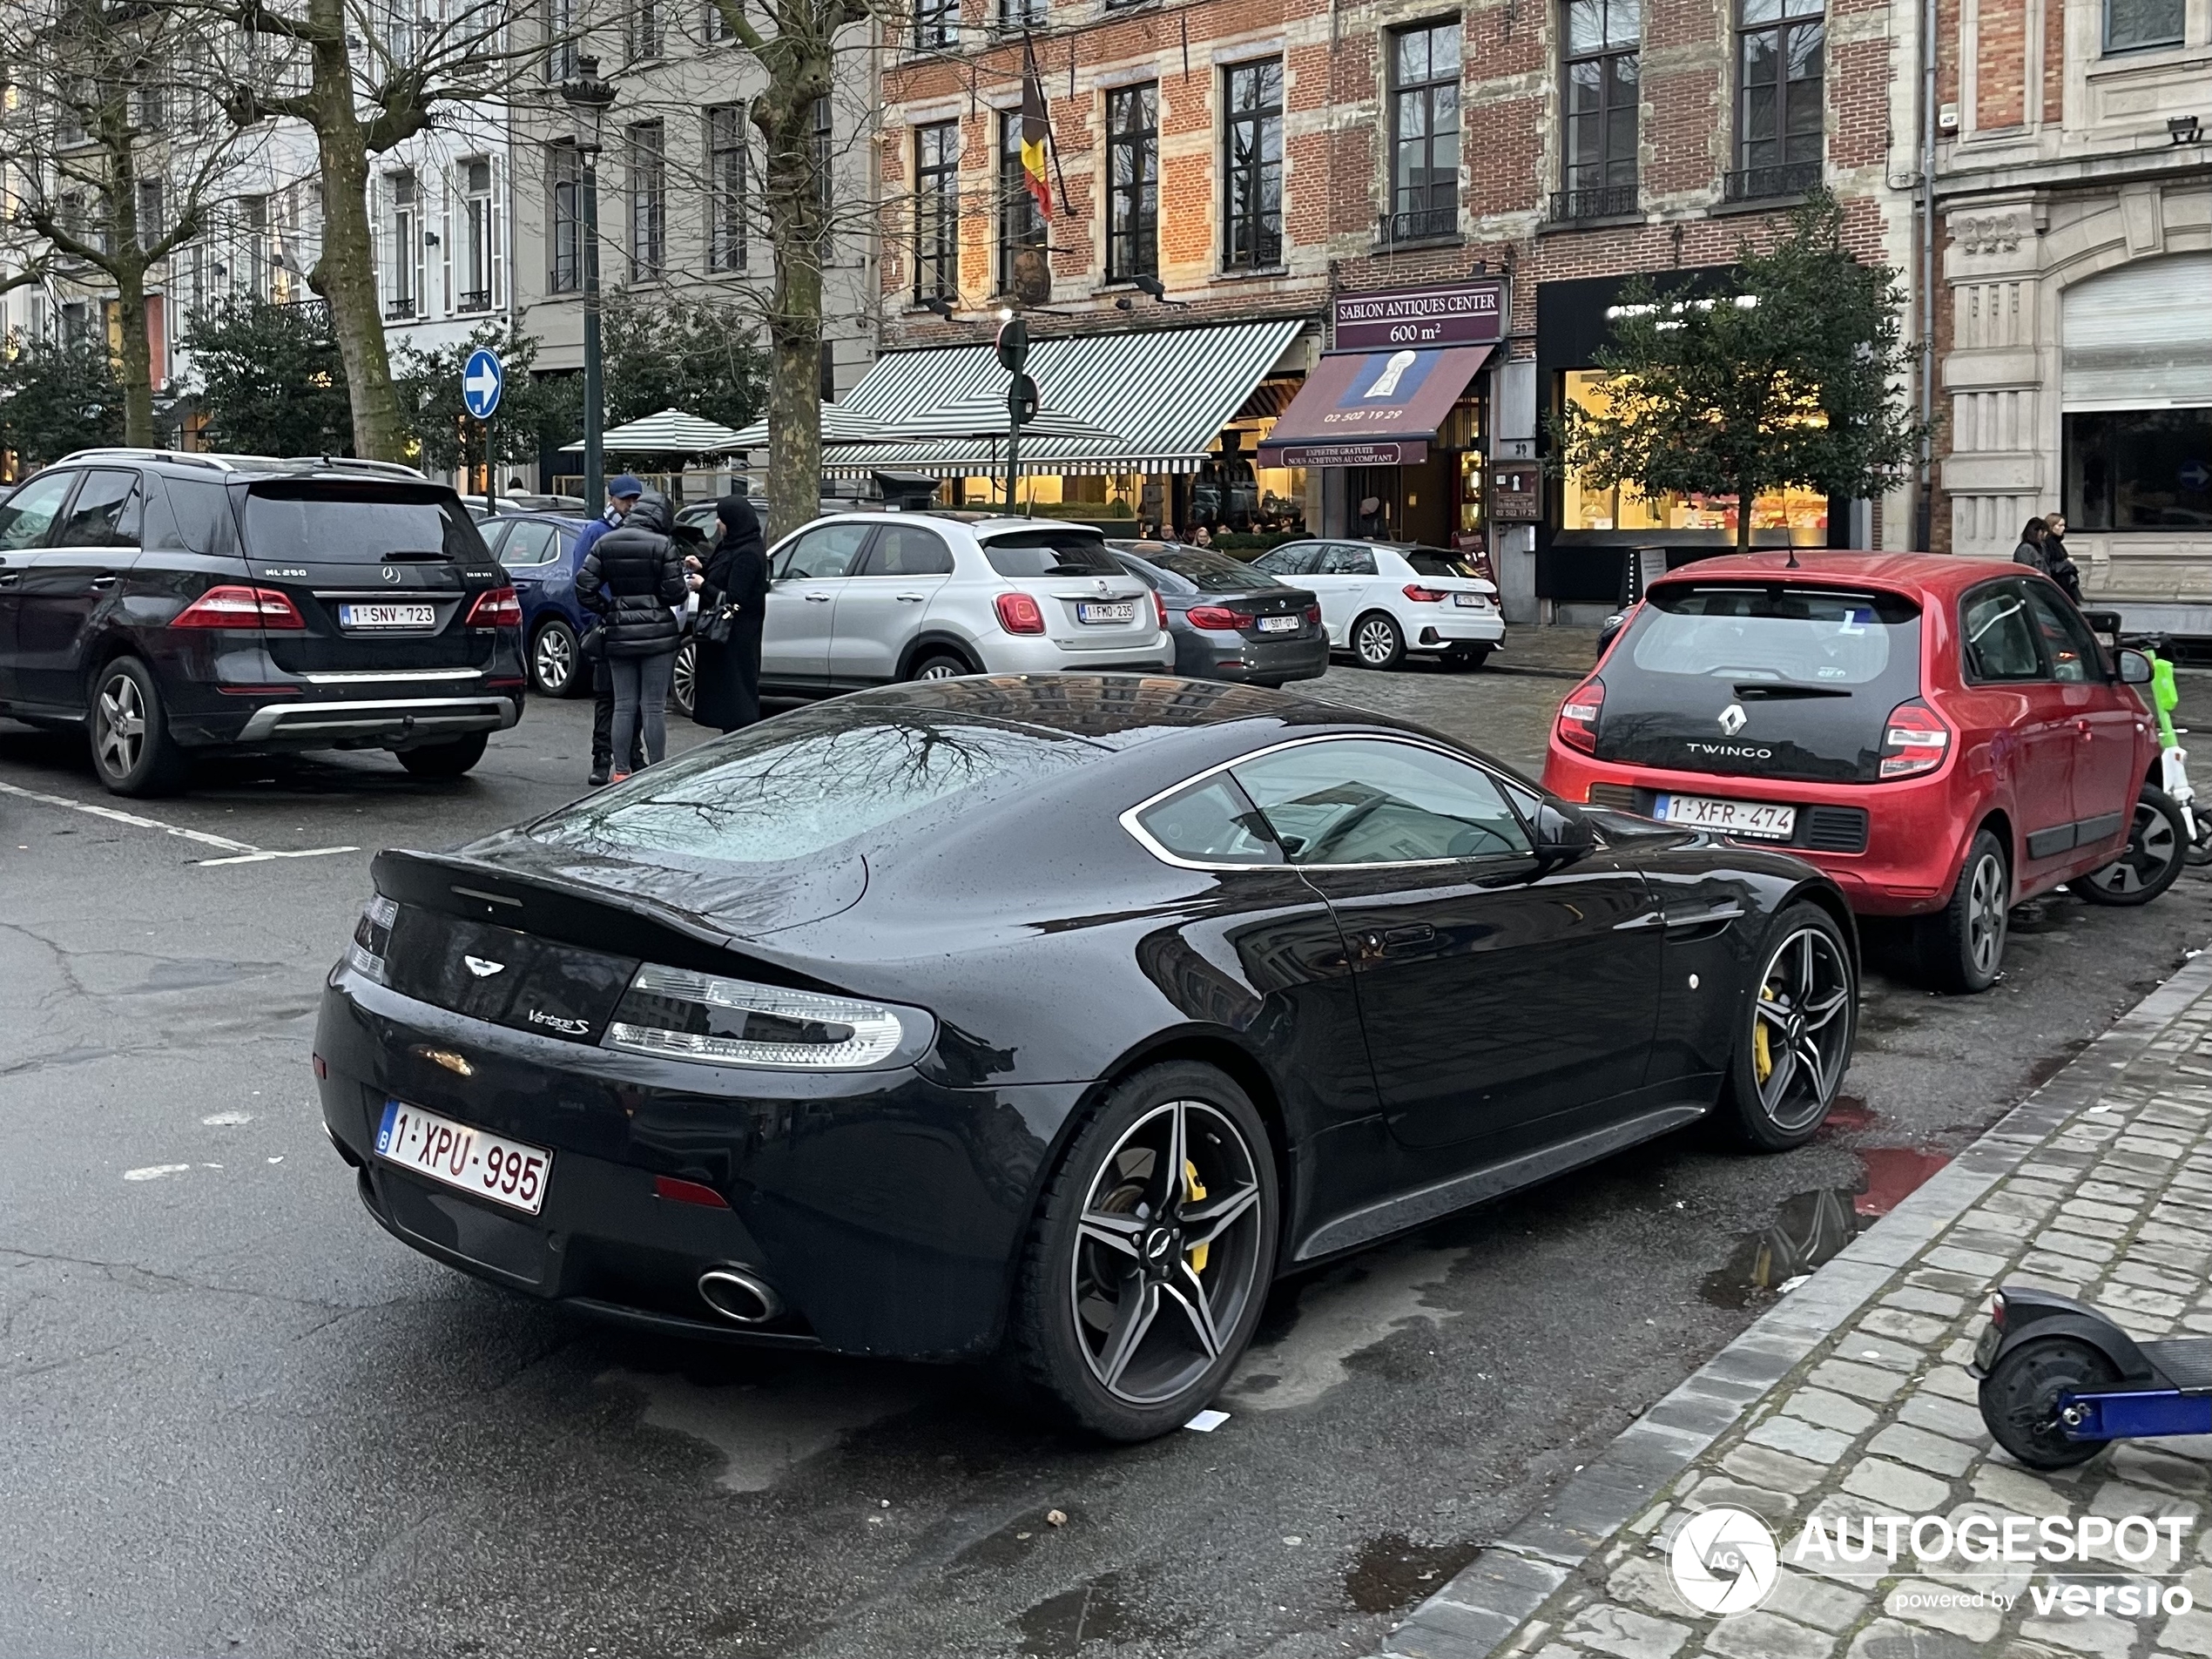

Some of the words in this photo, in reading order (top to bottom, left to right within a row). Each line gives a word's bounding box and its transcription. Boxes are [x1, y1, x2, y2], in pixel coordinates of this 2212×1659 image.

[1339, 303, 1384, 320] SABLON
[1386, 298, 1446, 317] ANTIQUES
[1448, 294, 1496, 311] CENTER
[1390, 325, 1418, 342] 600
[1324, 414, 1339, 422] 02
[1341, 412, 1364, 421] 502
[1368, 410, 1383, 420] 19
[1385, 410, 1403, 419] 29
[1306, 448, 1339, 456] EXPERTISE
[1340, 447, 1374, 455] GRATUITE
[1355, 455, 1393, 463] COMPTANT
[353, 607, 433, 622] 1-SNV-723
[1838, 610, 1865, 635] L
[1687, 743, 1772, 759] TWINGO
[1673, 799, 1792, 830] 1-XFR-474
[529, 1009, 575, 1030] Vantage
[566, 1019, 590, 1035] S
[378, 1130, 389, 1150] B
[396, 1114, 543, 1201] 1-XPU-995
